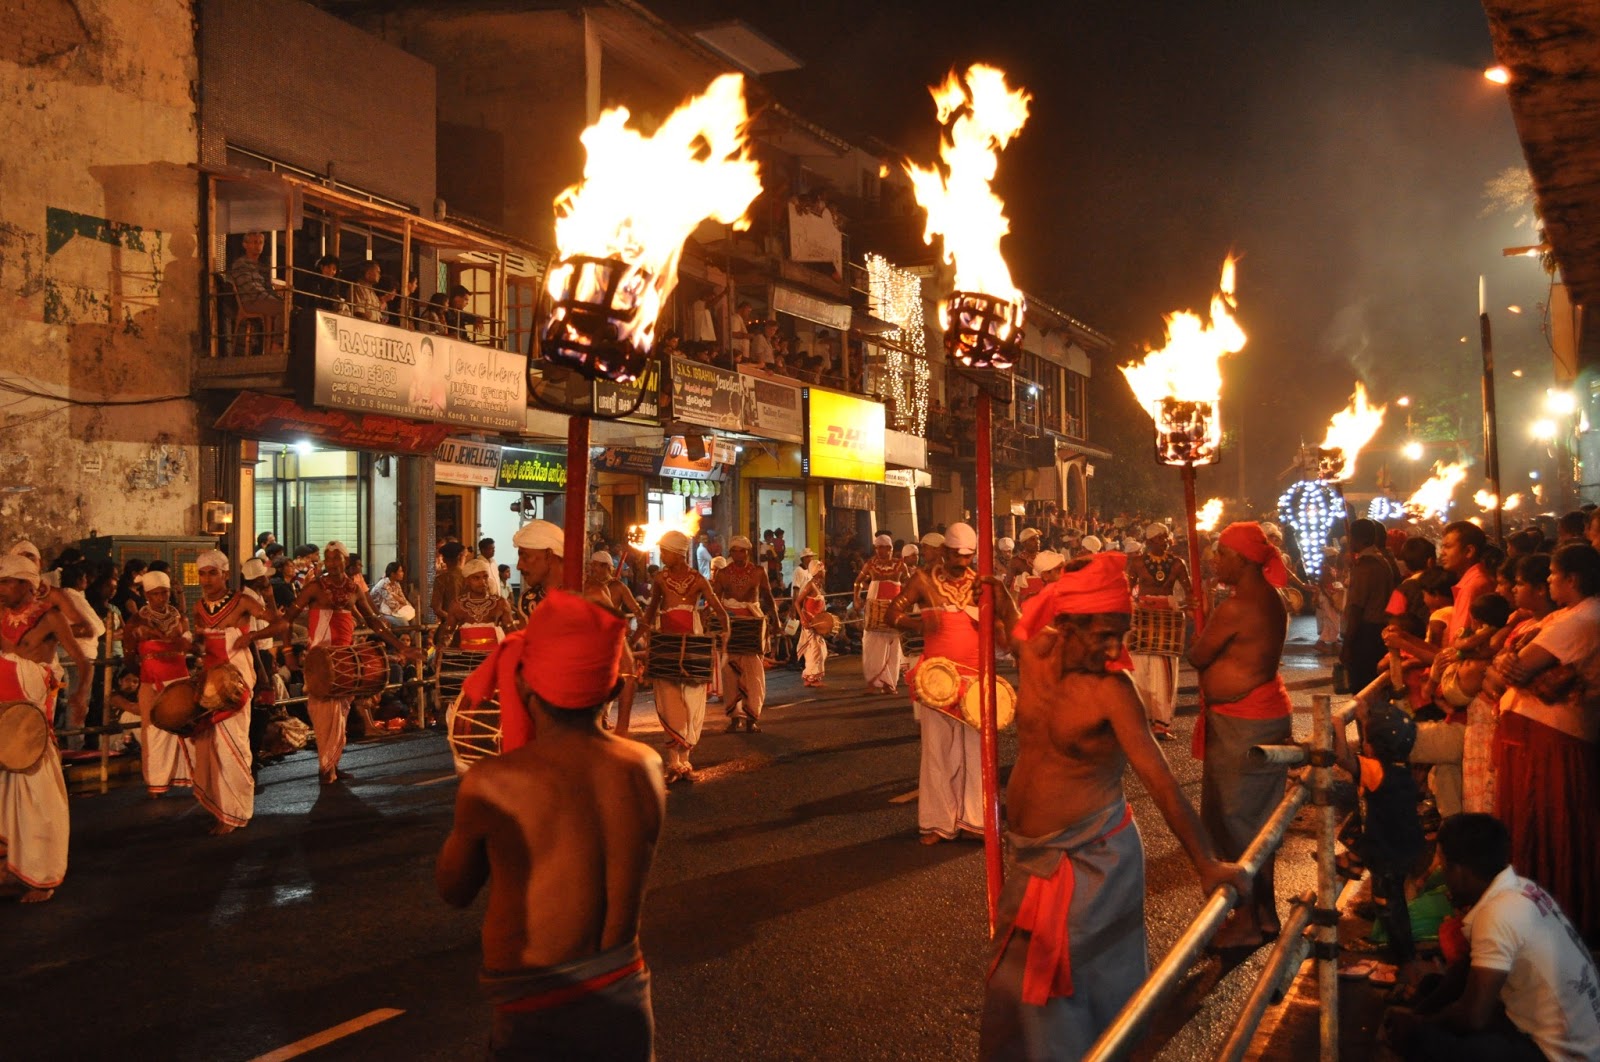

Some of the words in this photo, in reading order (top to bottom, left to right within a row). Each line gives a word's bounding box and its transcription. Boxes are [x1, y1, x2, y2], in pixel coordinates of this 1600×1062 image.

[339, 329, 416, 365] RATHIKA
[444, 345, 522, 400] Jewellery
[331, 394, 344, 404] No.
[455, 446, 499, 468] JEWELLERS
